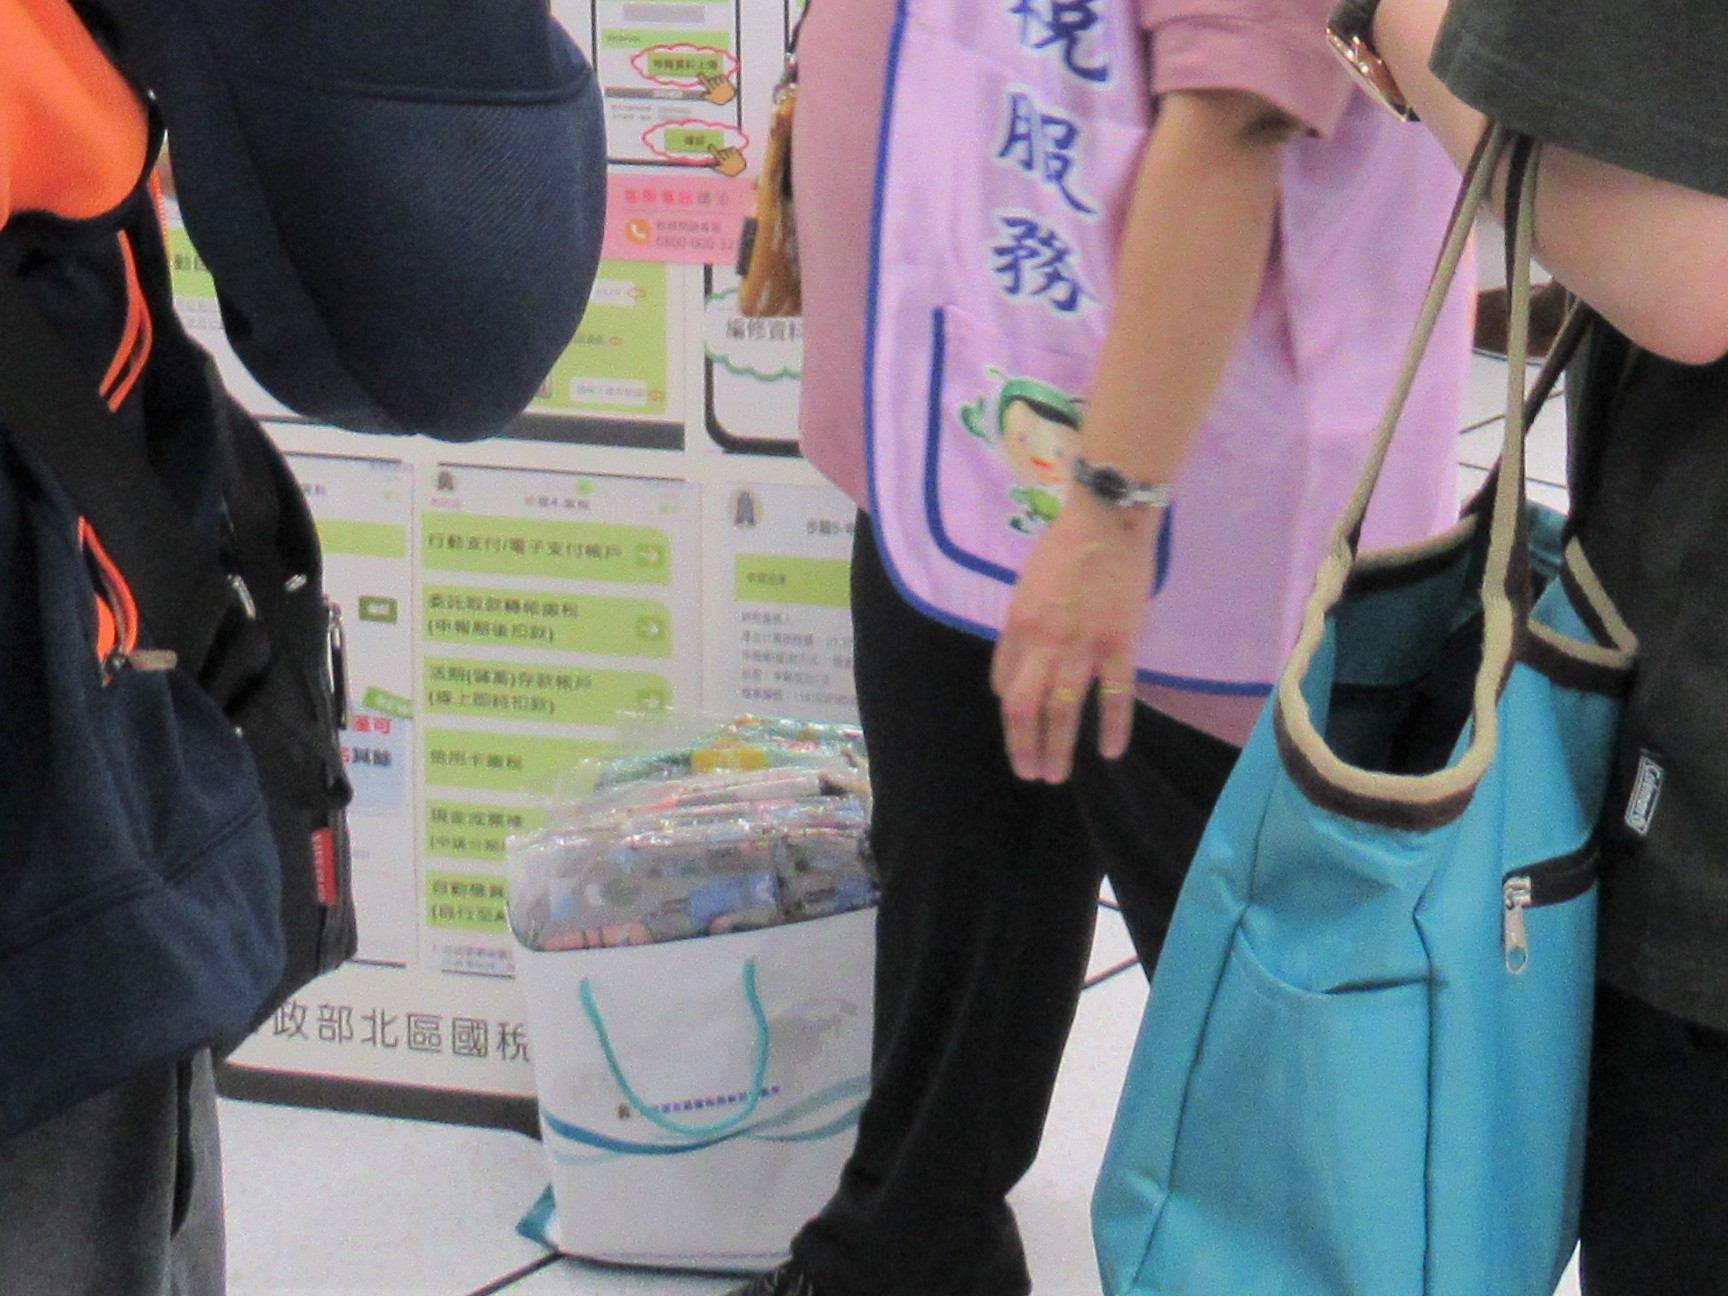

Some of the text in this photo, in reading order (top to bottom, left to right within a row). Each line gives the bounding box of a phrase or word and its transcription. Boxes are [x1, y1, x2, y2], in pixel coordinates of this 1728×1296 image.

[270, 998, 532, 1065] 政部北區國稅
